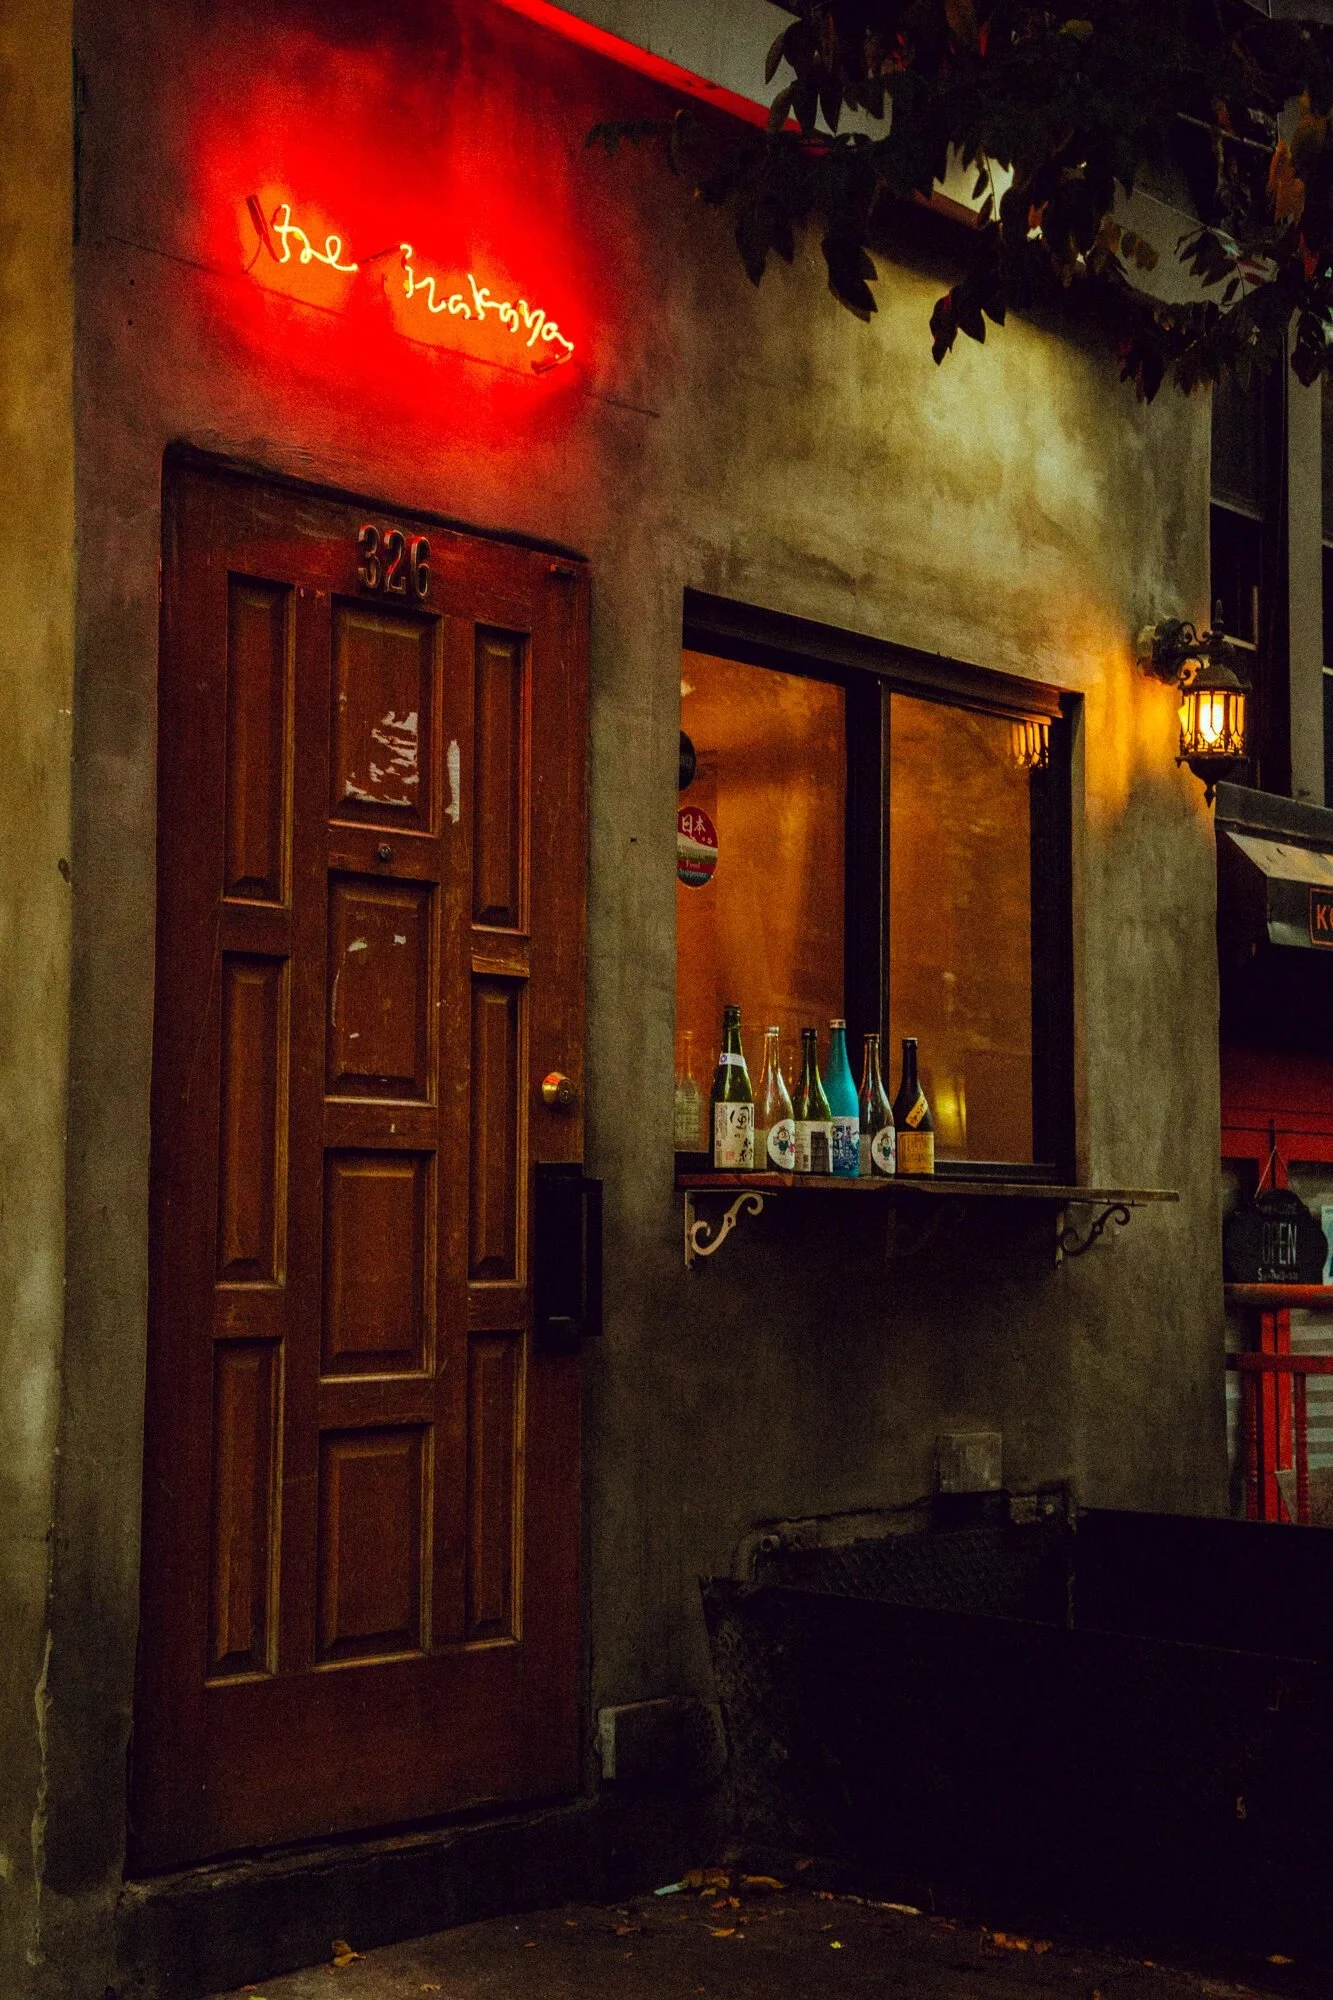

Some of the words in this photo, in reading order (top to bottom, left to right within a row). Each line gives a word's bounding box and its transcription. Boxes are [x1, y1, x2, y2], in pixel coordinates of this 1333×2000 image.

[273, 203, 358, 272] the
[358, 524, 432, 601] 326
[1316, 904, 1333, 930] K
[1262, 1222, 1298, 1265] OPEN
